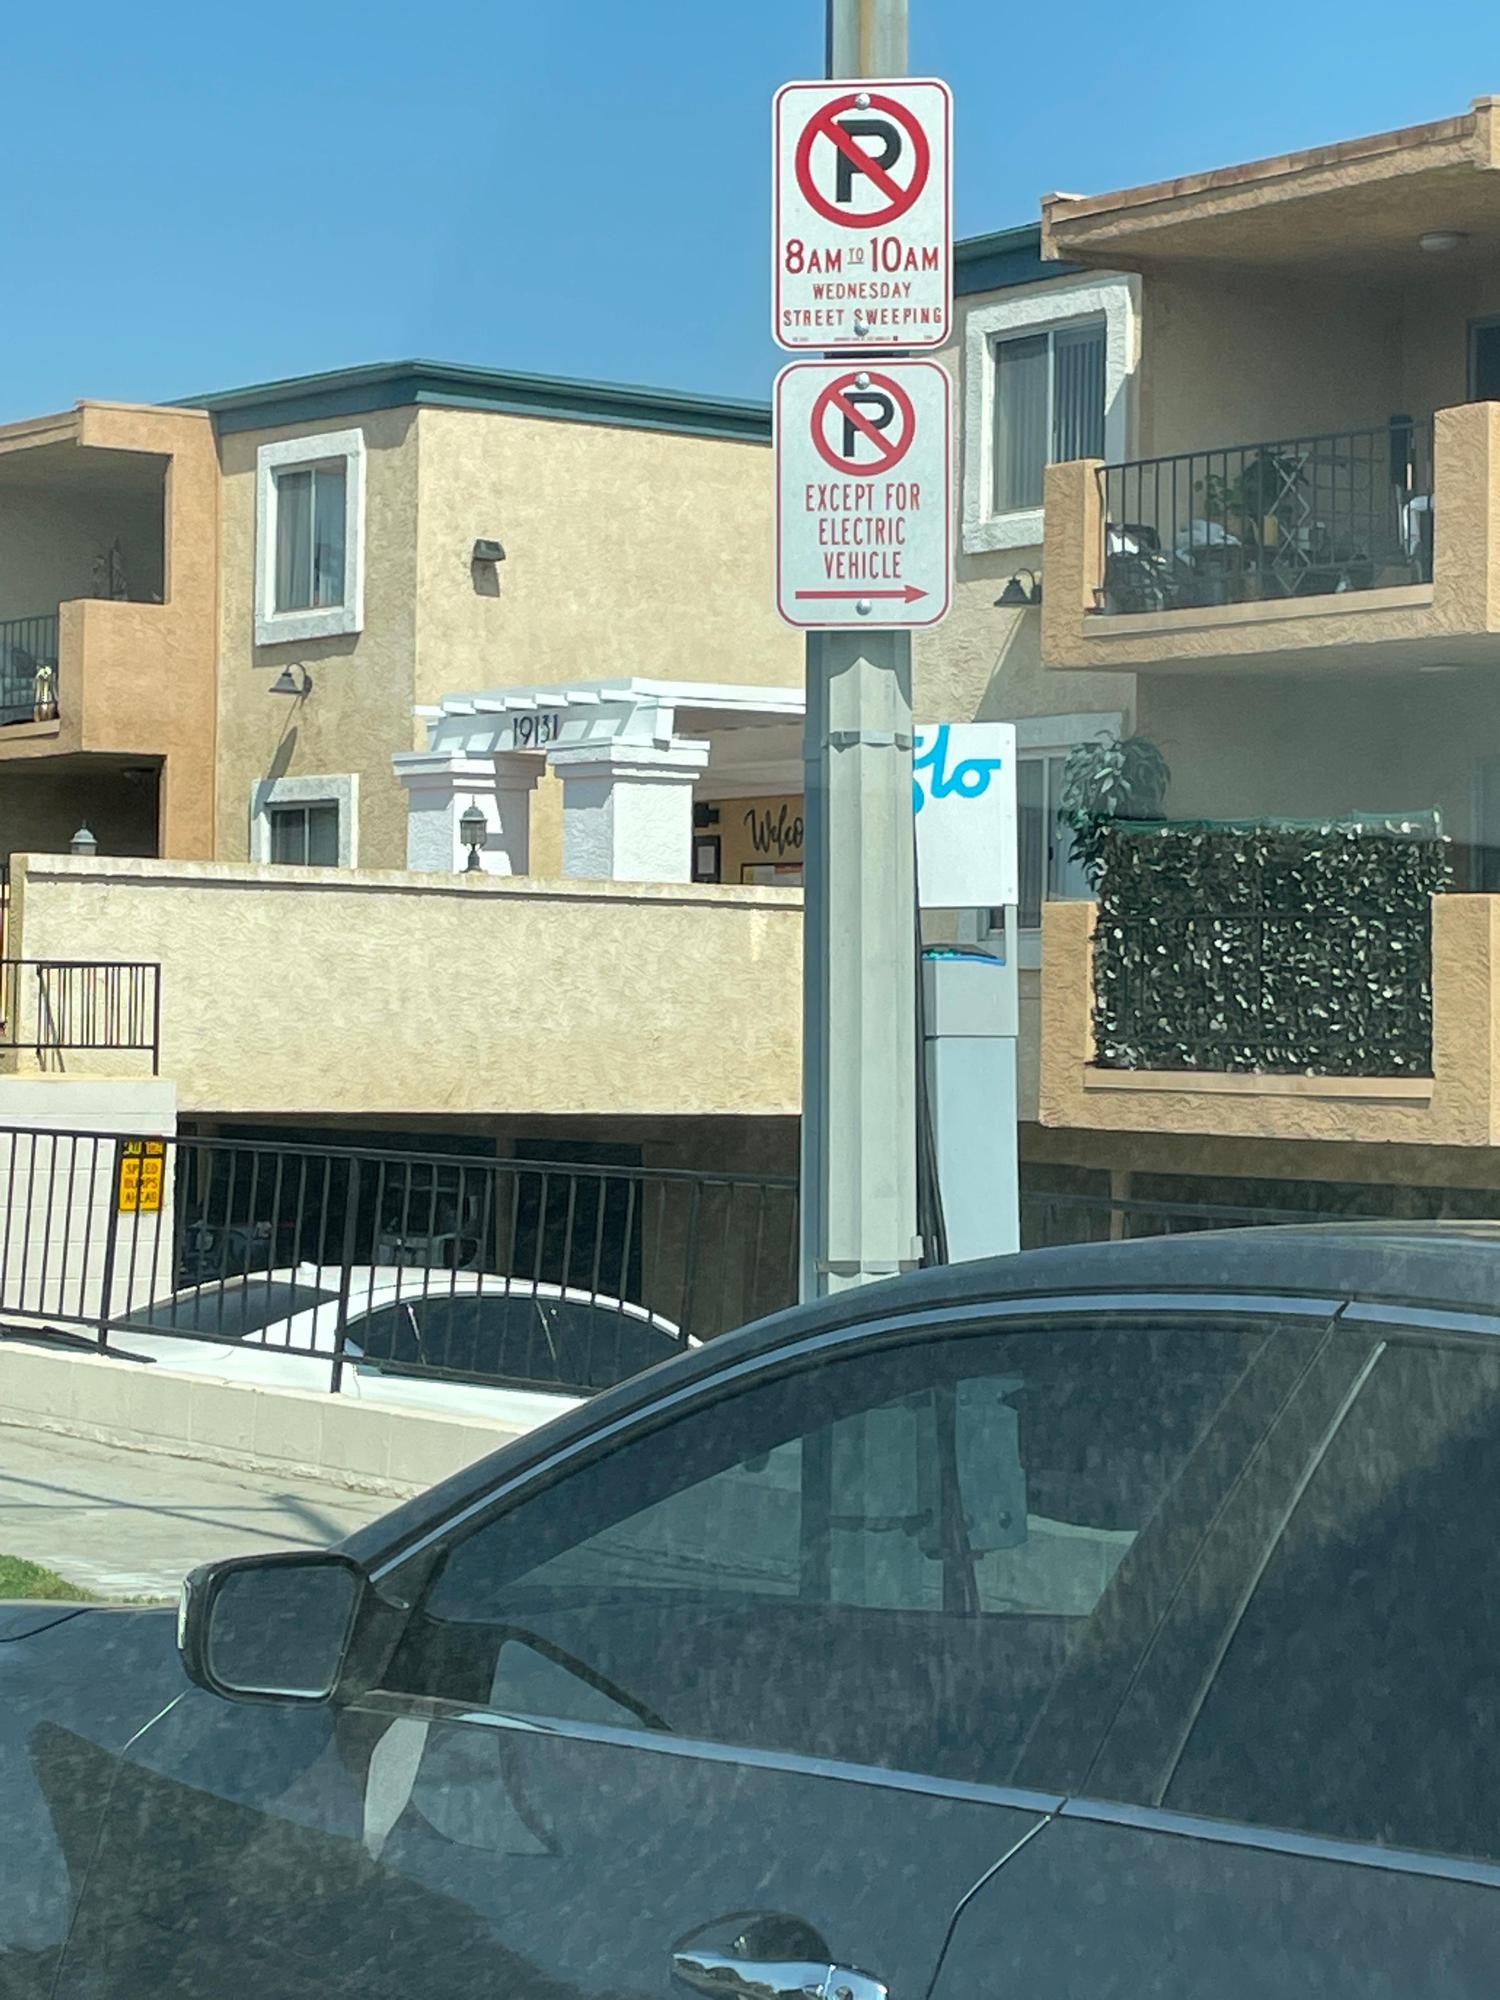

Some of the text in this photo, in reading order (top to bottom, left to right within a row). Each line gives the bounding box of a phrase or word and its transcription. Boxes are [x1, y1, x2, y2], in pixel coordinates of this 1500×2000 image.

[785, 236, 939, 274] 8AM TO 10AM
[813, 282, 912, 300] WEDNESDAY
[783, 306, 942, 326] STREET SWEEPING
[805, 482, 921, 512] EXCEPT FOR
[819, 517, 906, 546] ELECTRIC
[824, 551, 902, 580] VEHICLE
[513, 713, 558, 746] 19131
[743, 804, 804, 857] Welco
[125, 1162, 158, 1175] SPED
[123, 1177, 158, 1190] BUPS
